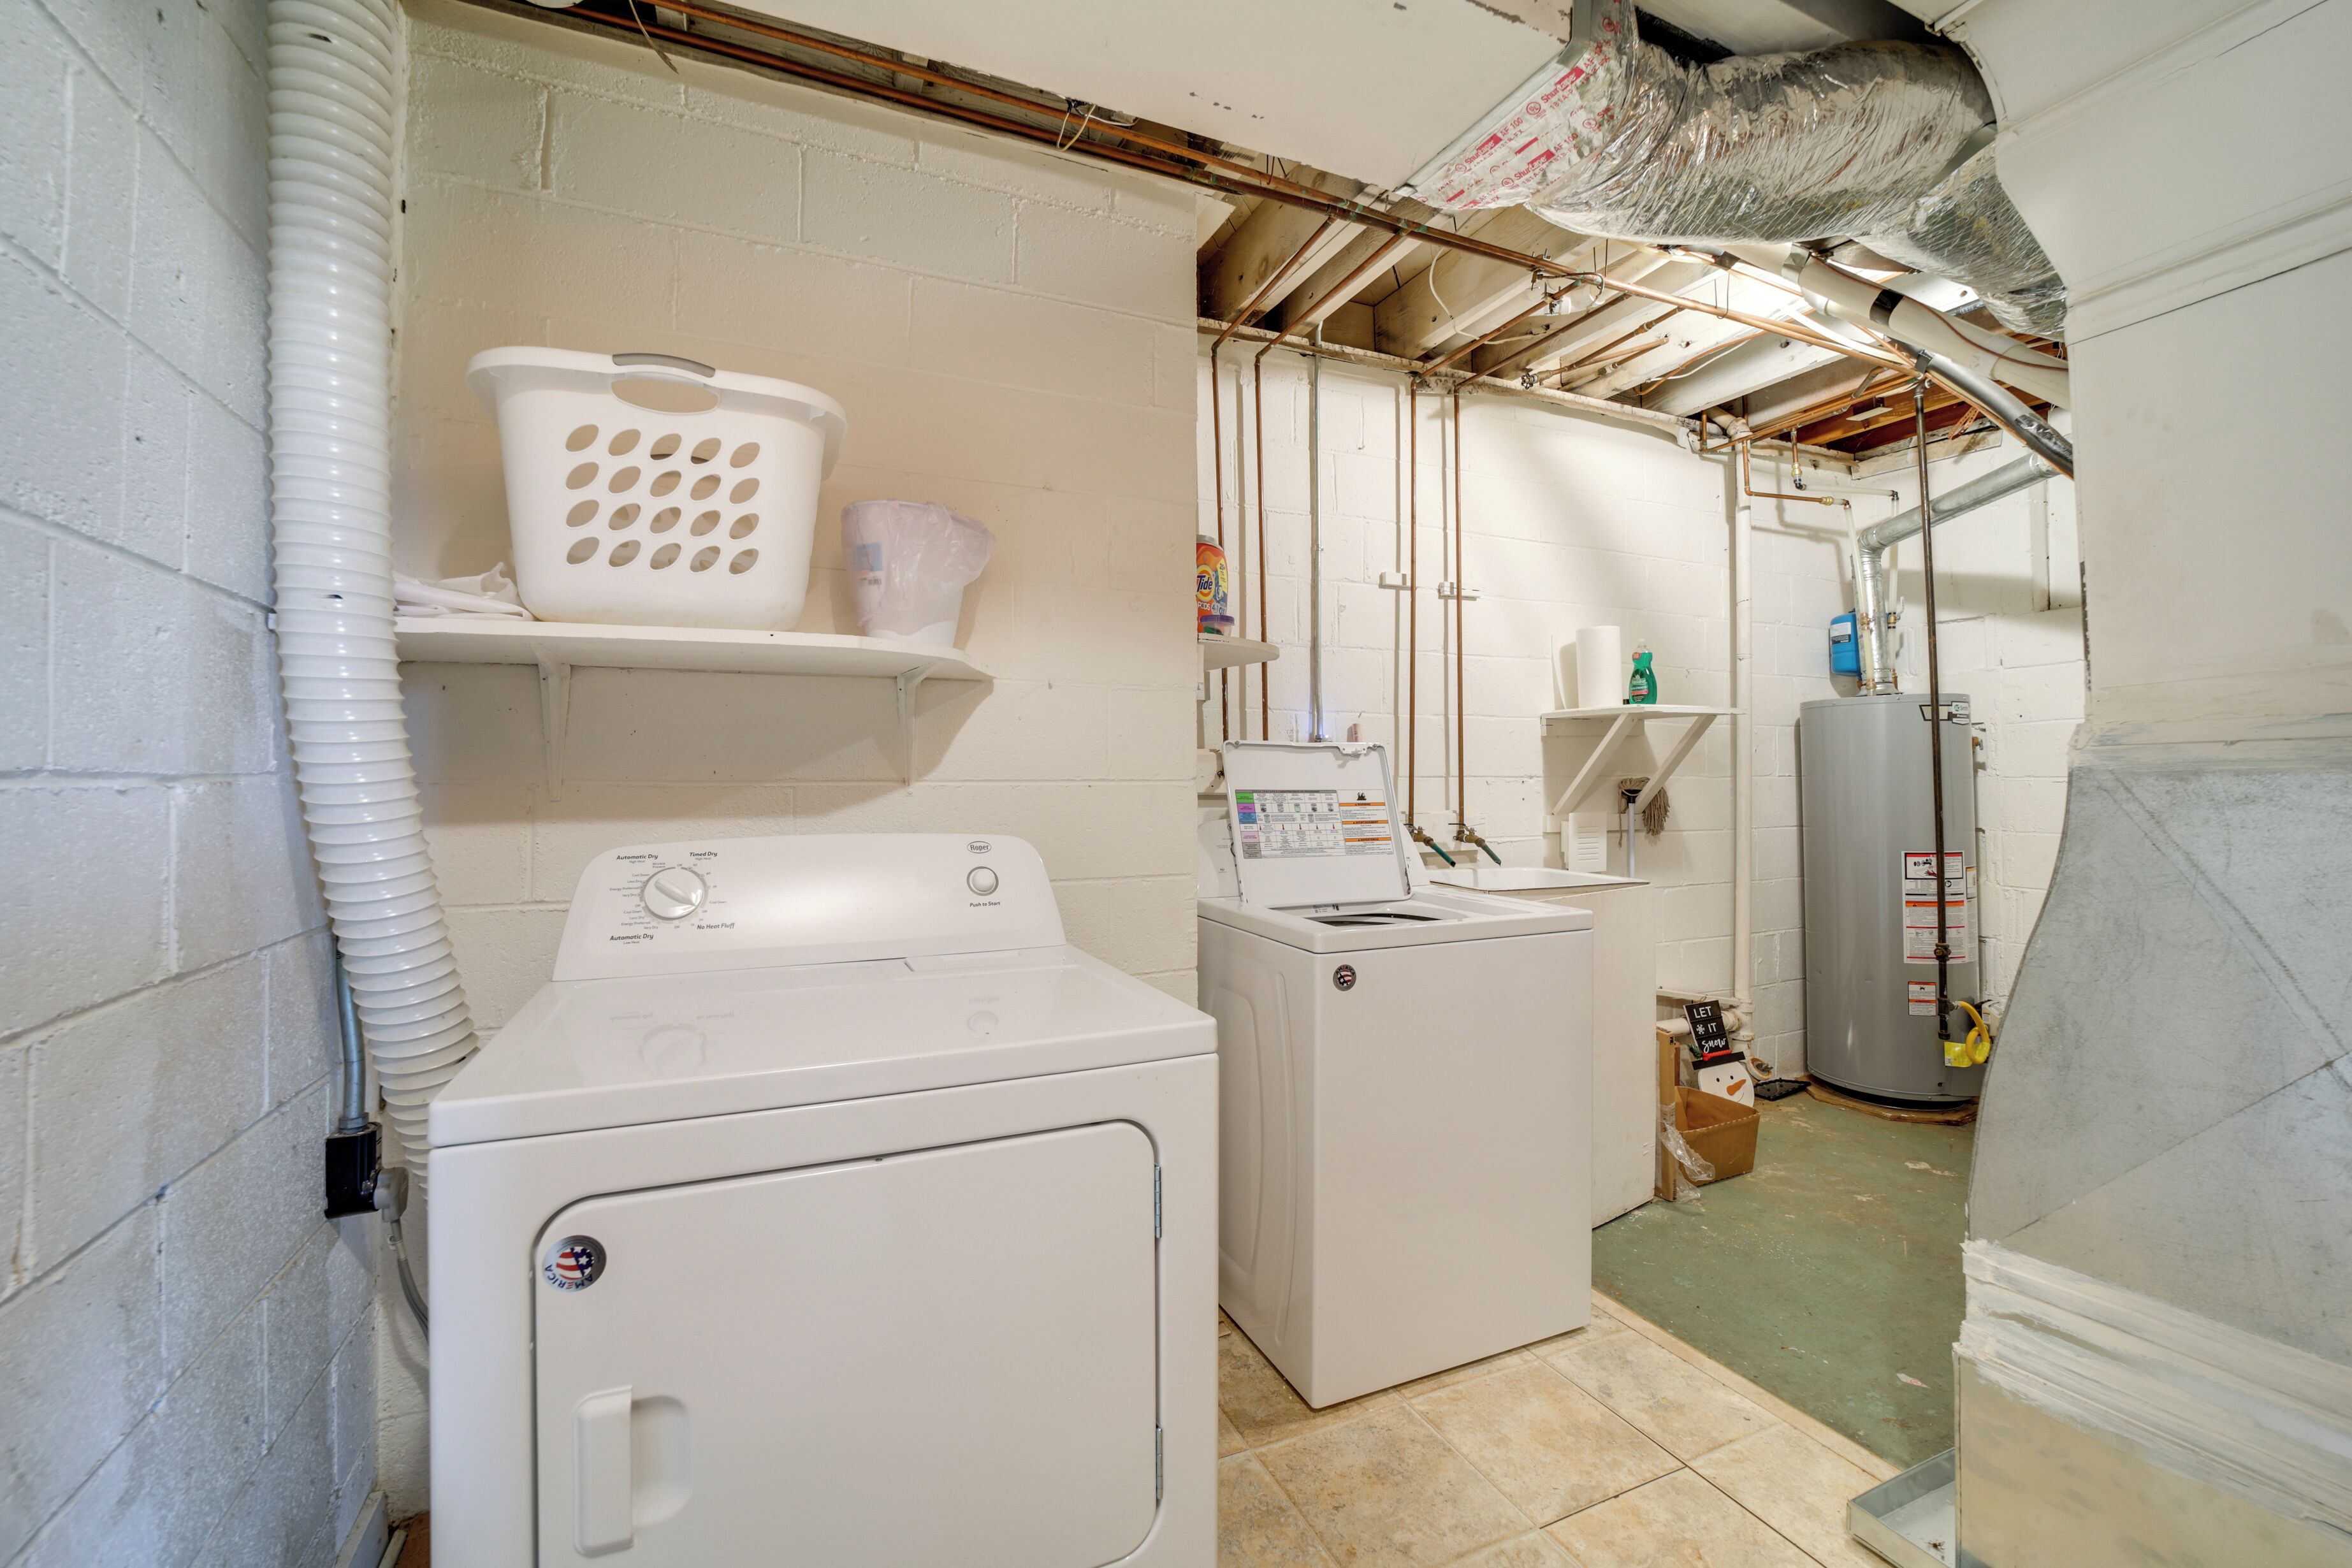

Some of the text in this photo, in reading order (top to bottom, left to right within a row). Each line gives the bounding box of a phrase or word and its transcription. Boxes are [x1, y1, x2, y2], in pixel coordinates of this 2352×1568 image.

[1500, 126, 1509, 136] AF
[1510, 117, 1523, 129] 100
[1554, 142, 1564, 152] AF
[1564, 133, 1578, 143] 100
[1196, 575, 1213, 592] Tide
[1335, 966, 1355, 976] AMERICA
[1693, 1006, 1712, 1019] LET
[1708, 1022, 1717, 1033] IT
[544, 1264, 593, 1289] AMERICA
